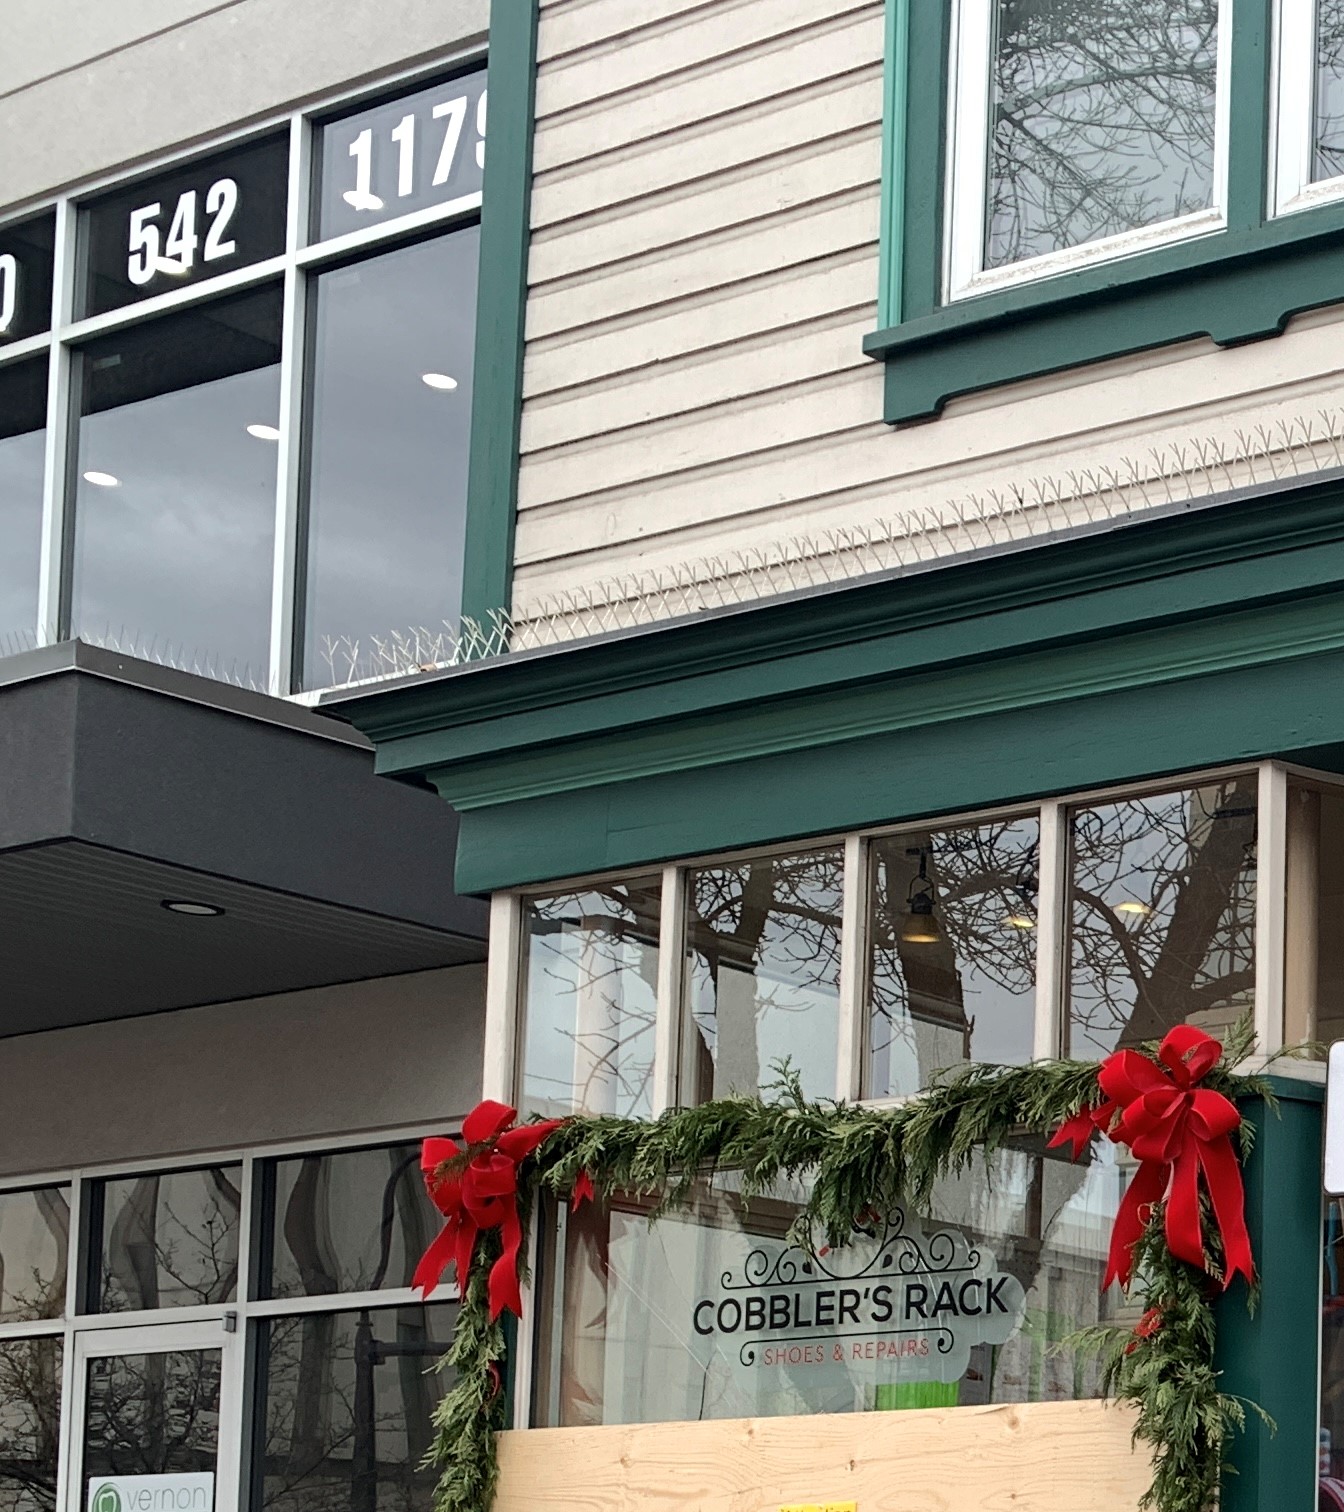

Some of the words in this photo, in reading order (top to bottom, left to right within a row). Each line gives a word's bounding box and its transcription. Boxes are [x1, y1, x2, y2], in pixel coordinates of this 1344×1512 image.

[128, 178, 239, 286] 542
[692, 1284, 893, 1336] COBBLER'S
[904, 1275, 1010, 1320] RACK
[763, 1343, 825, 1366] SHOES
[832, 1343, 844, 1361] &
[852, 1338, 931, 1361] REPAIRS
[127, 1486, 206, 1511] vernon
